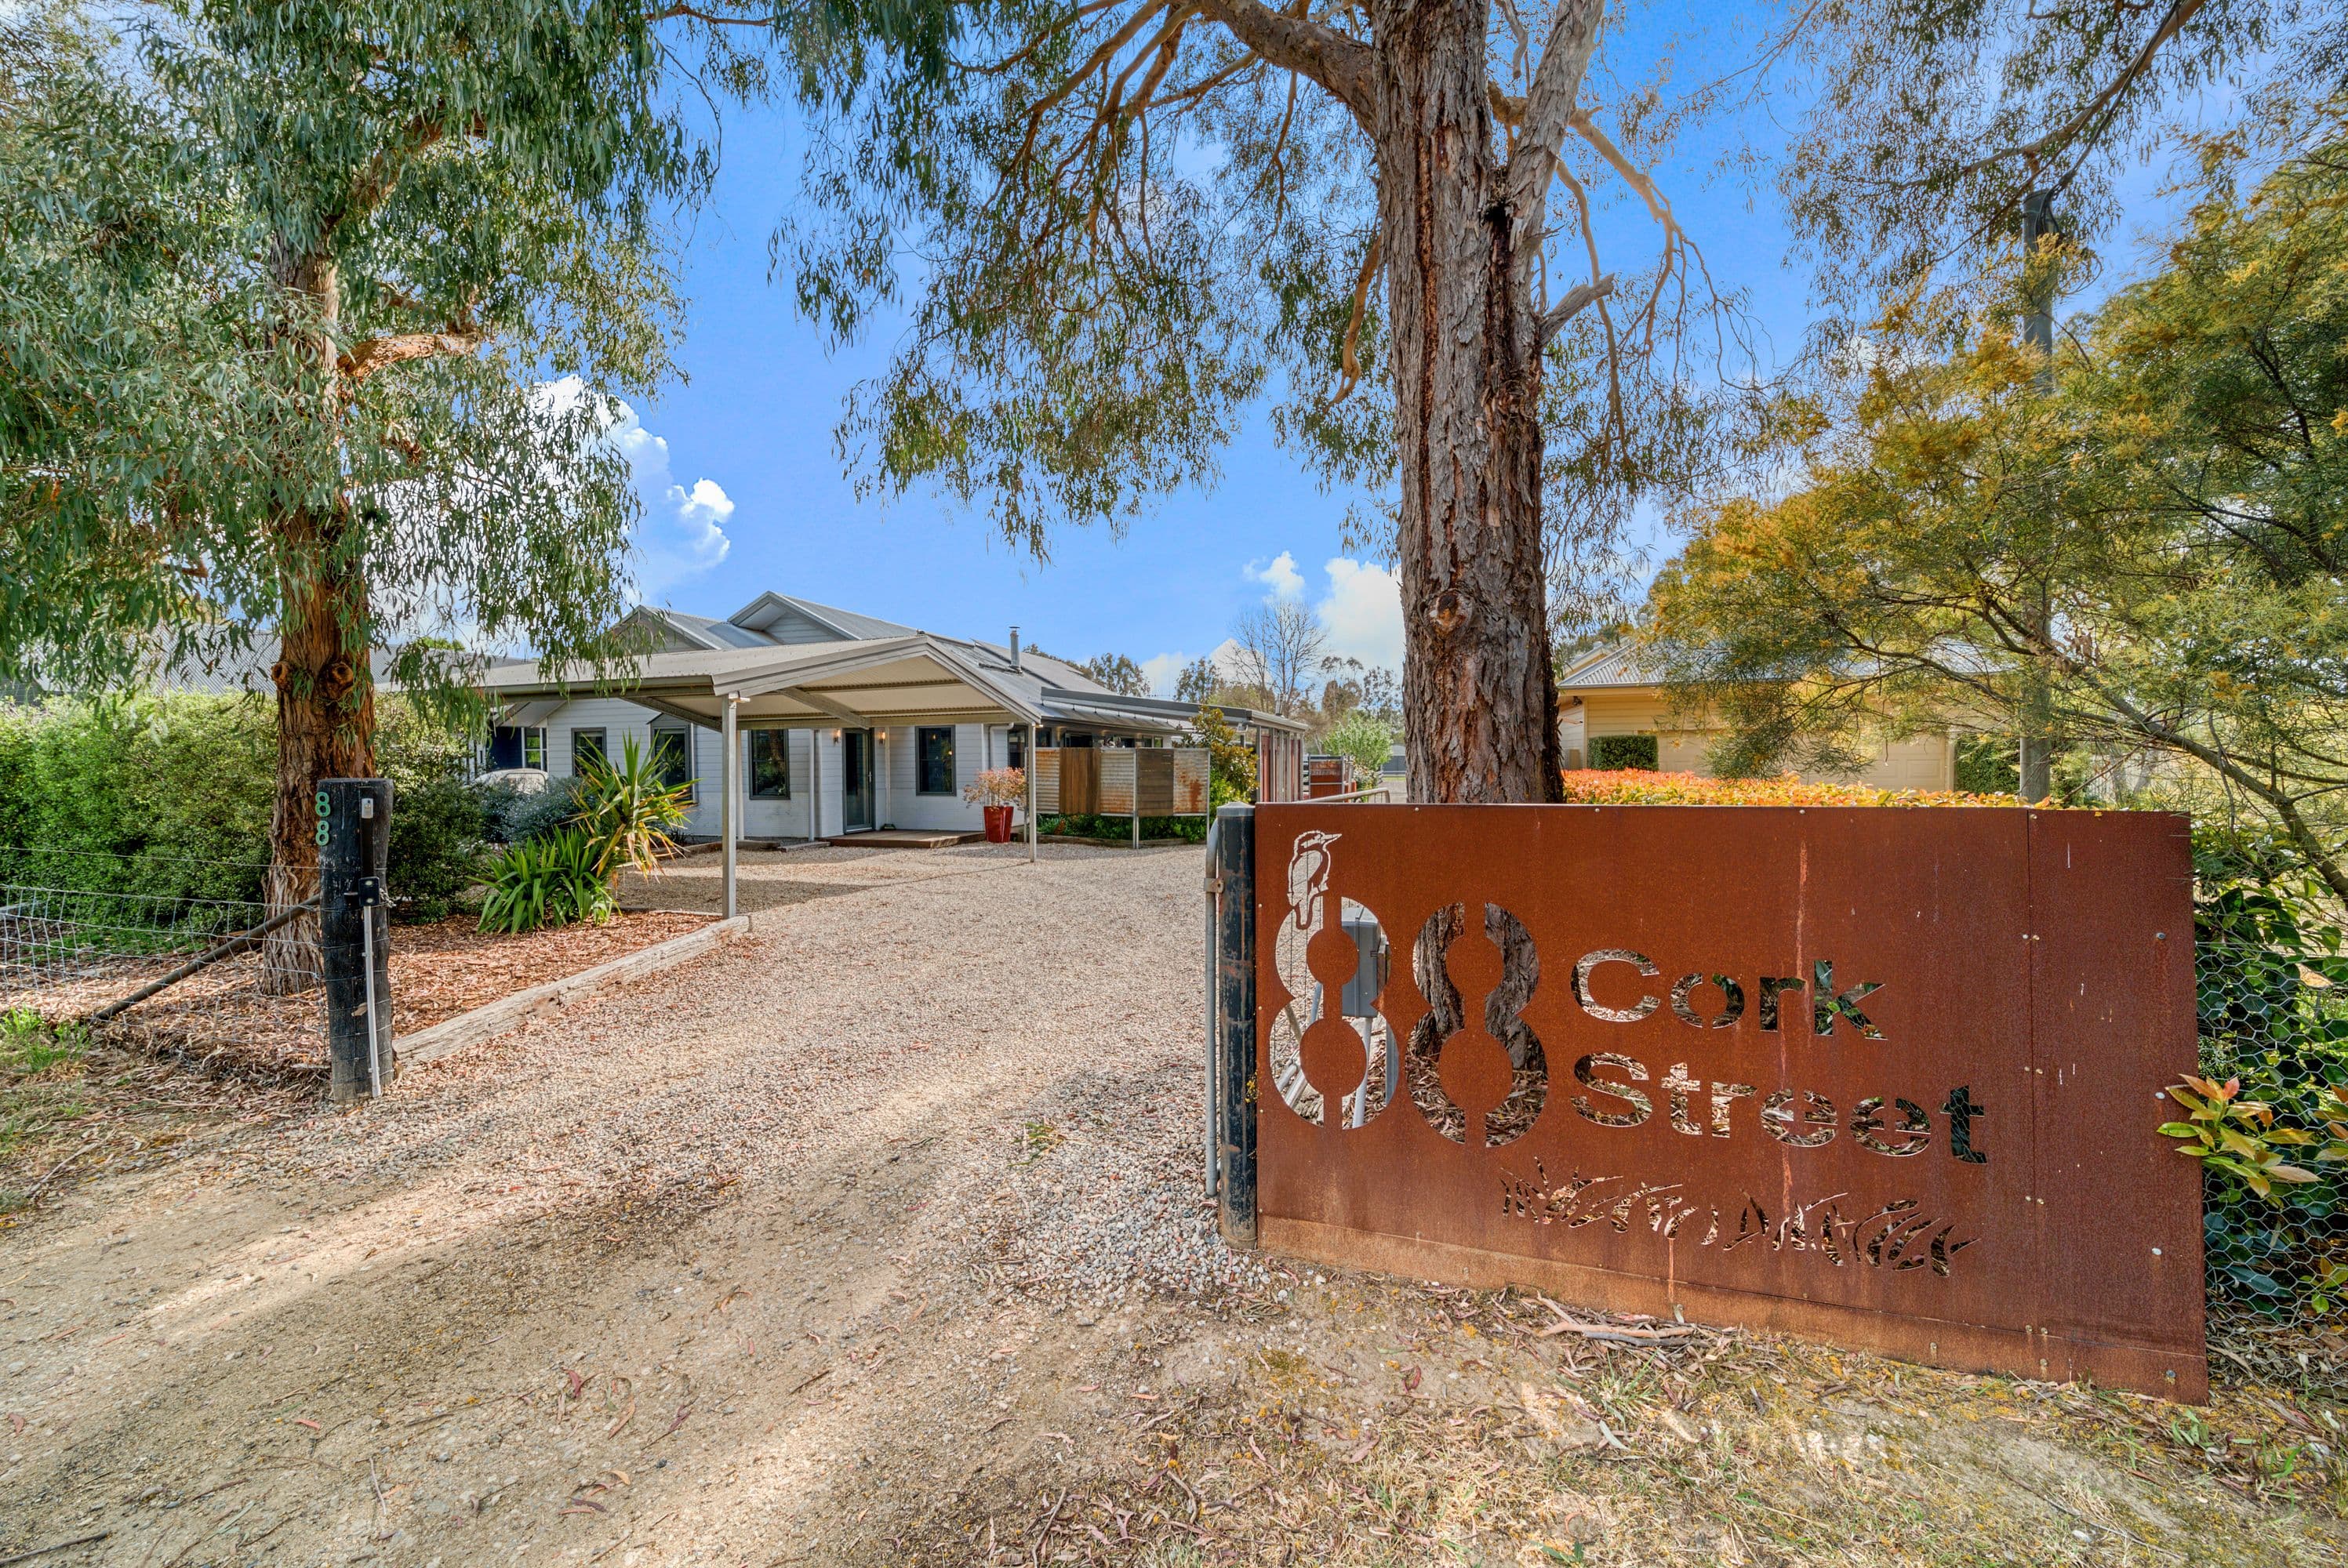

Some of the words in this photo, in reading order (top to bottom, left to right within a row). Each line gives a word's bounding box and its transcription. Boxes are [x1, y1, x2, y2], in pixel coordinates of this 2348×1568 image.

[314, 791, 331, 847] 88
[1269, 895, 1550, 1149] 88
[1570, 948, 1888, 1041] Cork
[1570, 1051, 1988, 1165] Street
